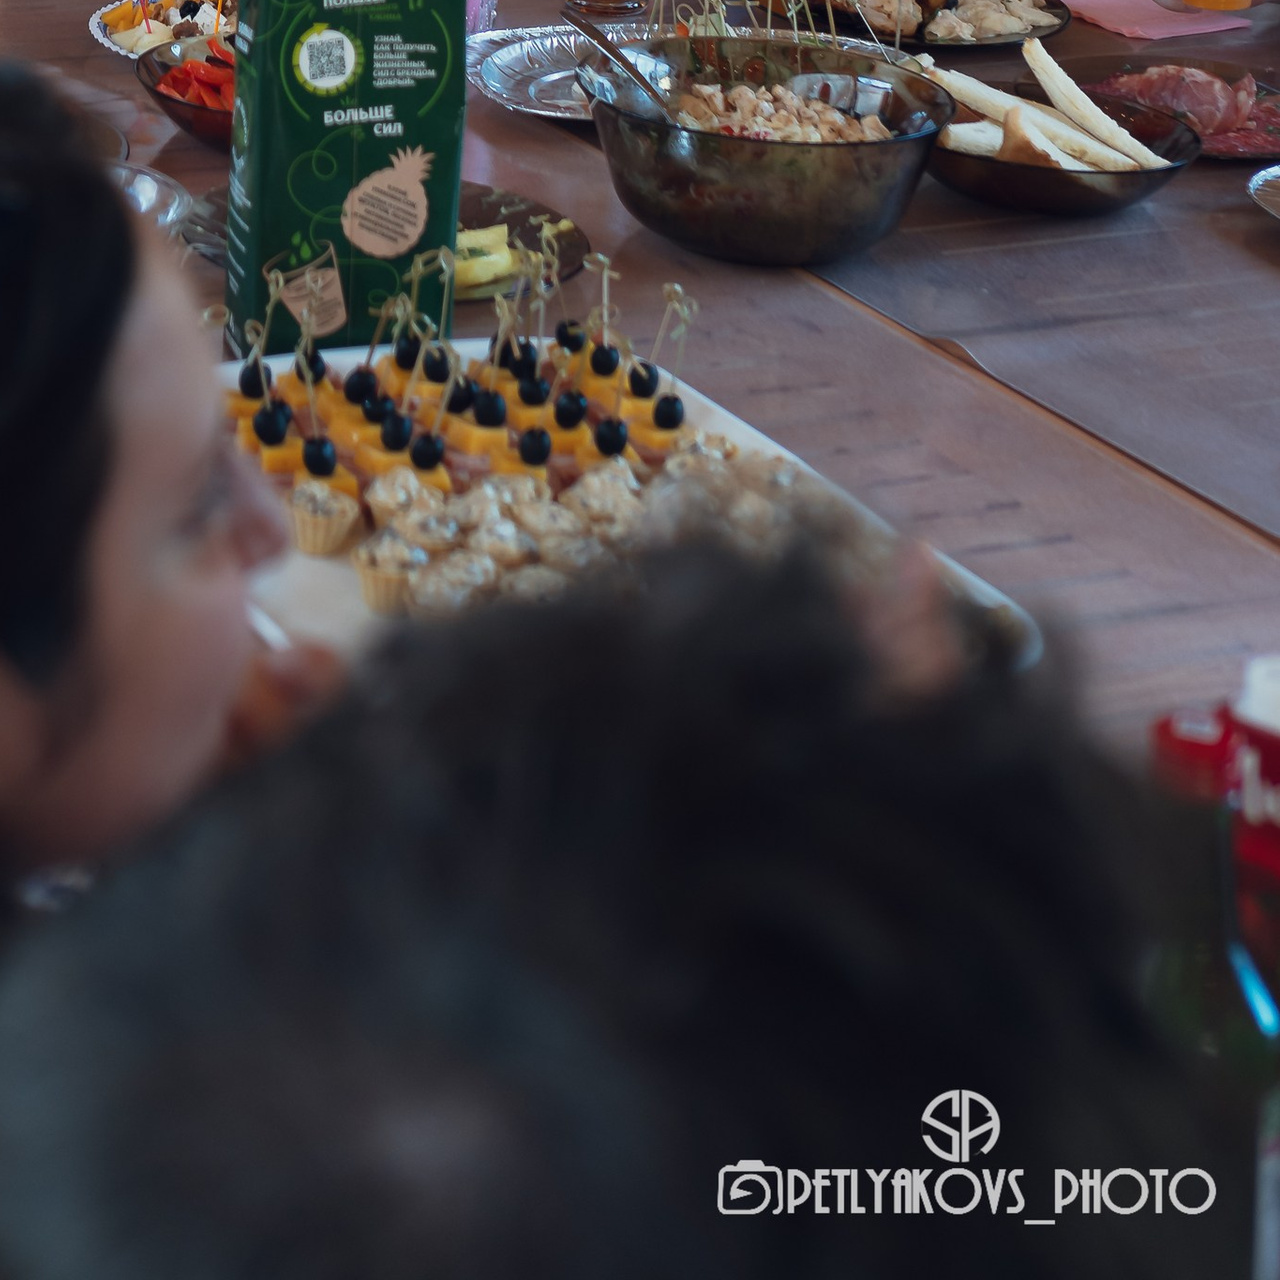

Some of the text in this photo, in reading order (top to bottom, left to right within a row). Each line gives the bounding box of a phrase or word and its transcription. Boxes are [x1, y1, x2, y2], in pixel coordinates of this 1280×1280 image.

[373, 43, 436, 51] КАК ПОЛУЧИТЬ
[373, 60, 426, 68] ЖИЗНЕННЫХ
[373, 69, 388, 77] СИЛ
[396, 69, 435, 77] БРЕНДОМ
[324, 105, 394, 125] БОЛЬШЕ
[373, 122, 404, 137] СИЛ
